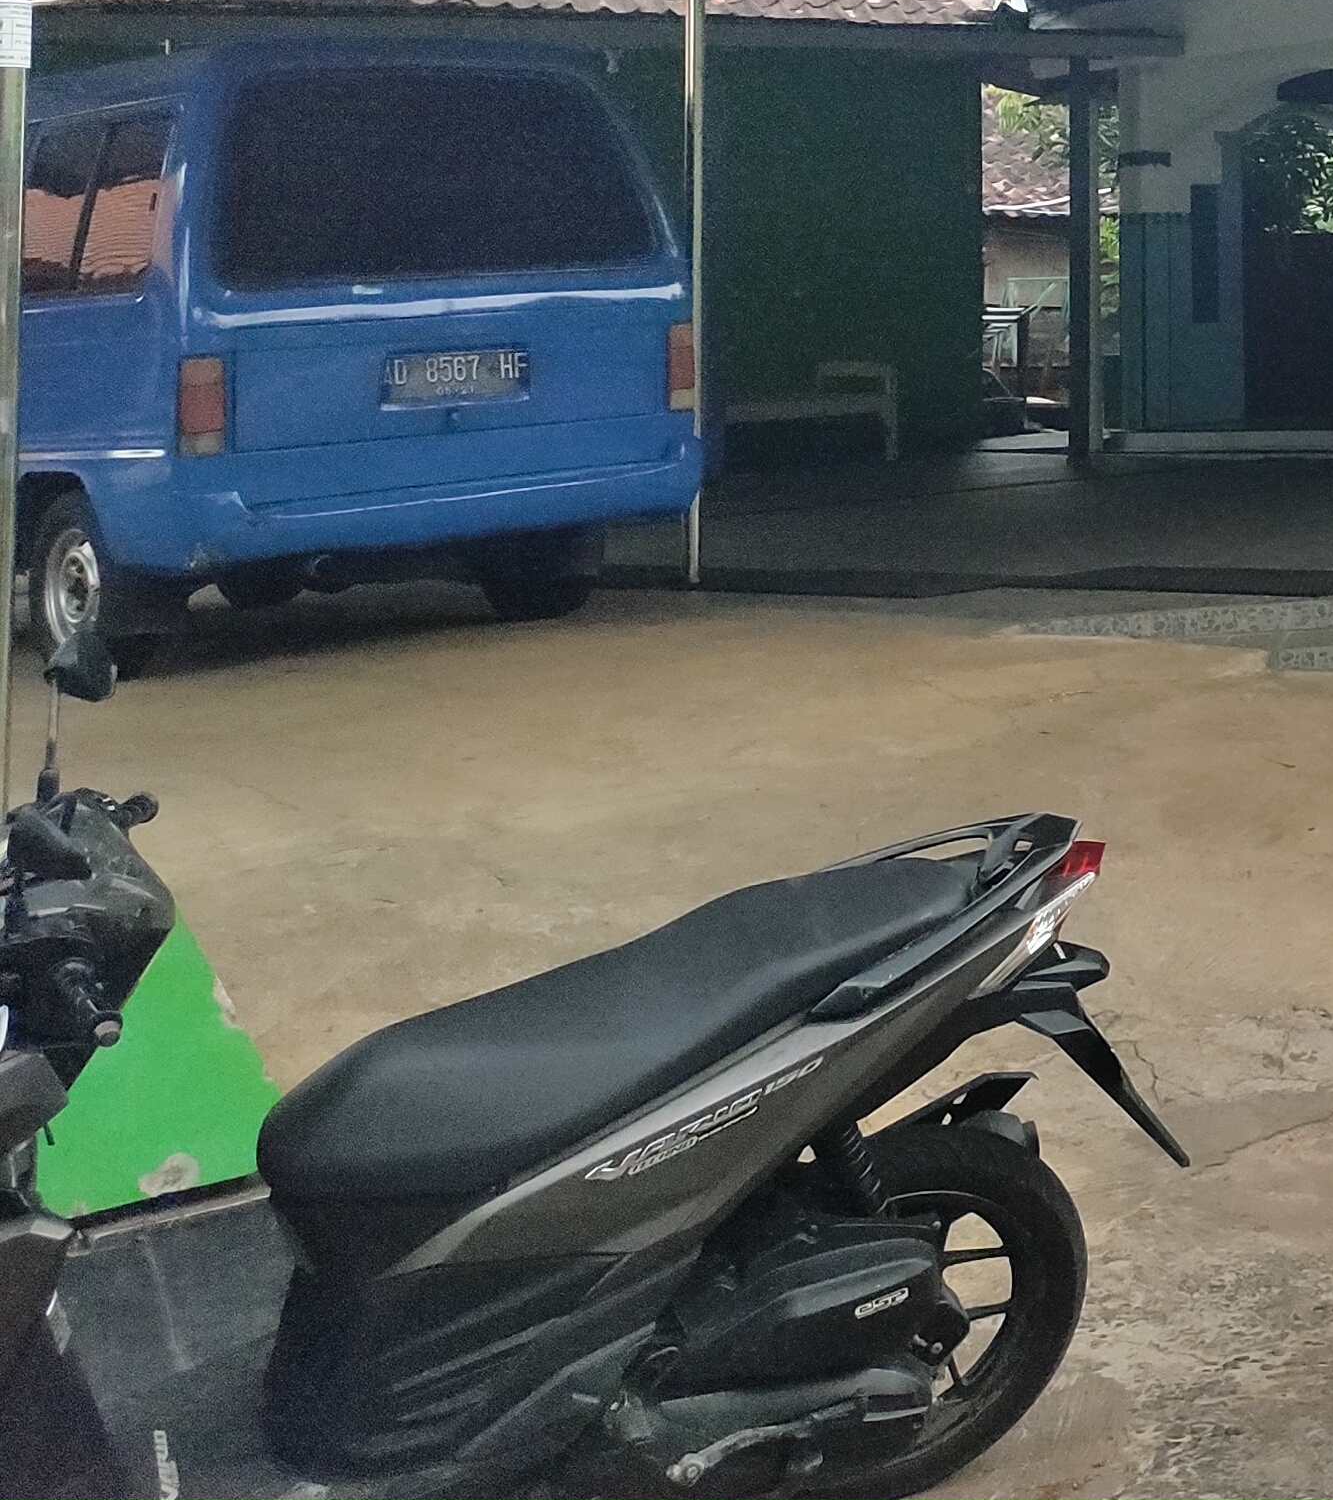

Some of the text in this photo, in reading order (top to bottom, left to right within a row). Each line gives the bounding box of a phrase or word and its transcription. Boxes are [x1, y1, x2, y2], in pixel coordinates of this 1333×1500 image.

[426, 355, 480, 383] 8567
[500, 352, 528, 379] HF
[763, 1056, 824, 1096] 150
